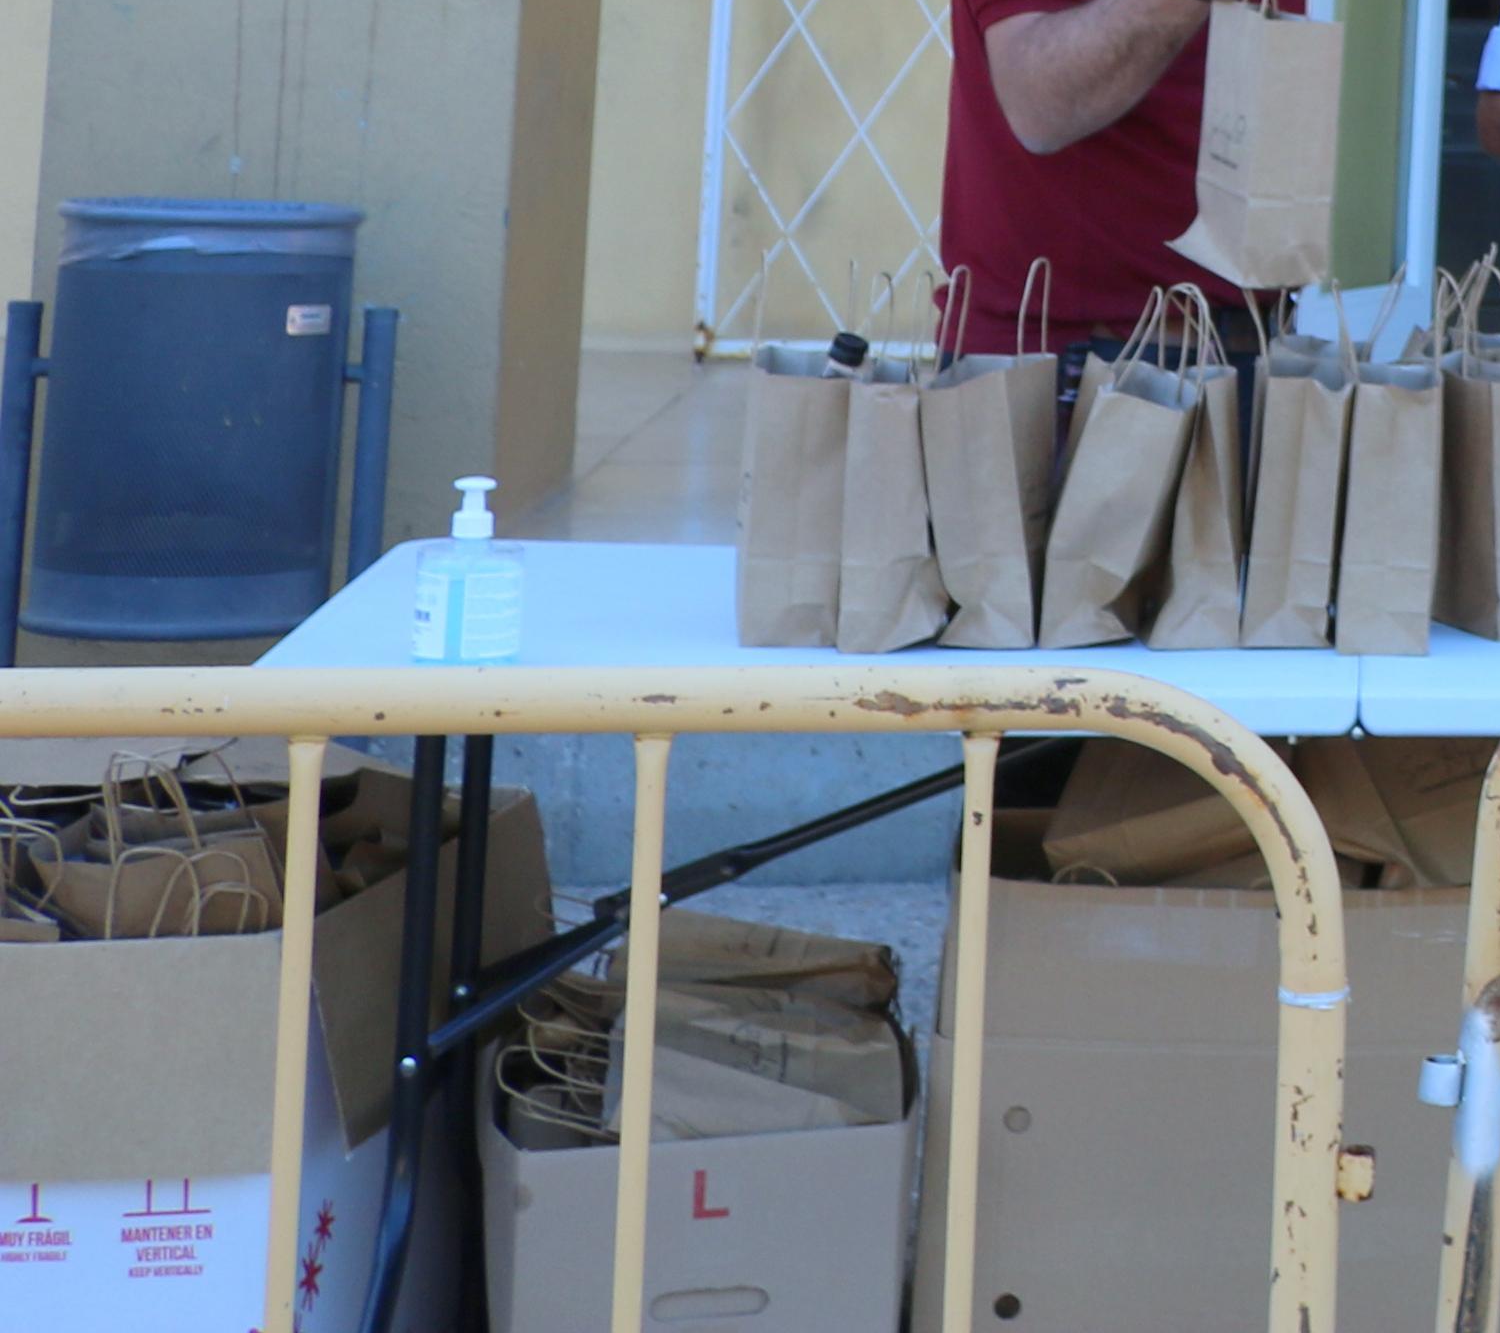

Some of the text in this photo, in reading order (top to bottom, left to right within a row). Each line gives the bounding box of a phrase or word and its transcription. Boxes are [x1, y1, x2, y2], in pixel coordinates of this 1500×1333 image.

[692, 1169, 731, 1220] L
[28, 1228, 73, 1247] FRÁGIL
[120, 1224, 213, 1243] MANTENER EN
[136, 1245, 198, 1263] VERTICAL
[128, 1264, 204, 1278] KEEP VERTICALLY
